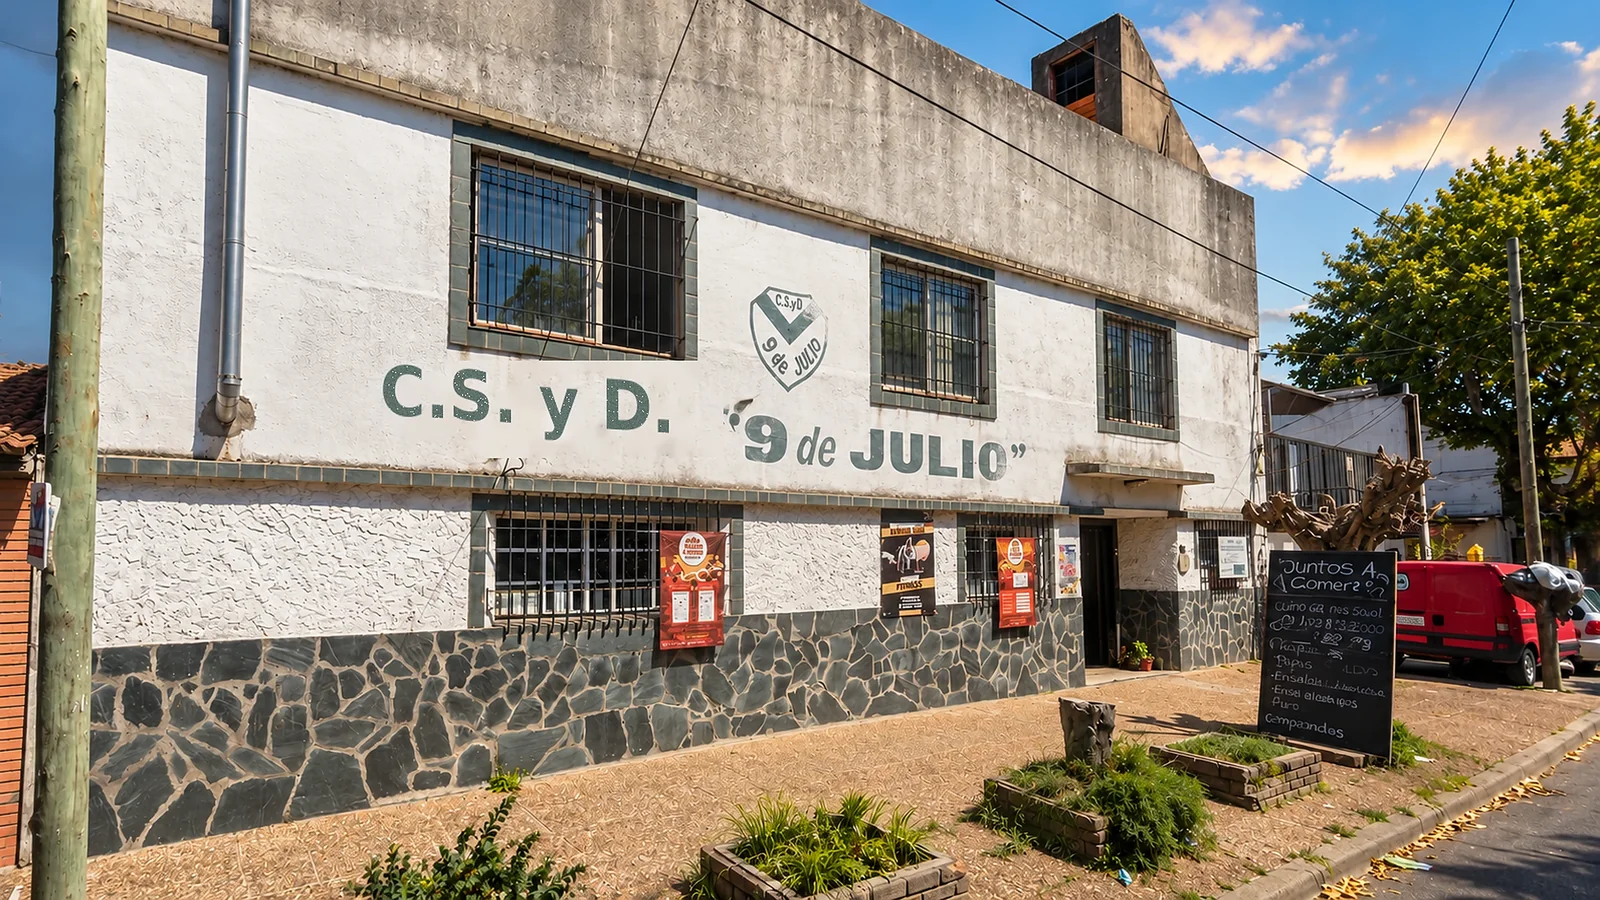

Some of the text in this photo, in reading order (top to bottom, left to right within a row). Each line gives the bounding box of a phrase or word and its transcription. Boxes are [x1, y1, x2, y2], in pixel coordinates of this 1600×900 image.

[762, 336, 821, 376] 9 de JULIO
[382, 364, 670, 441] C.S. y D.
[796, 426, 837, 468] de
